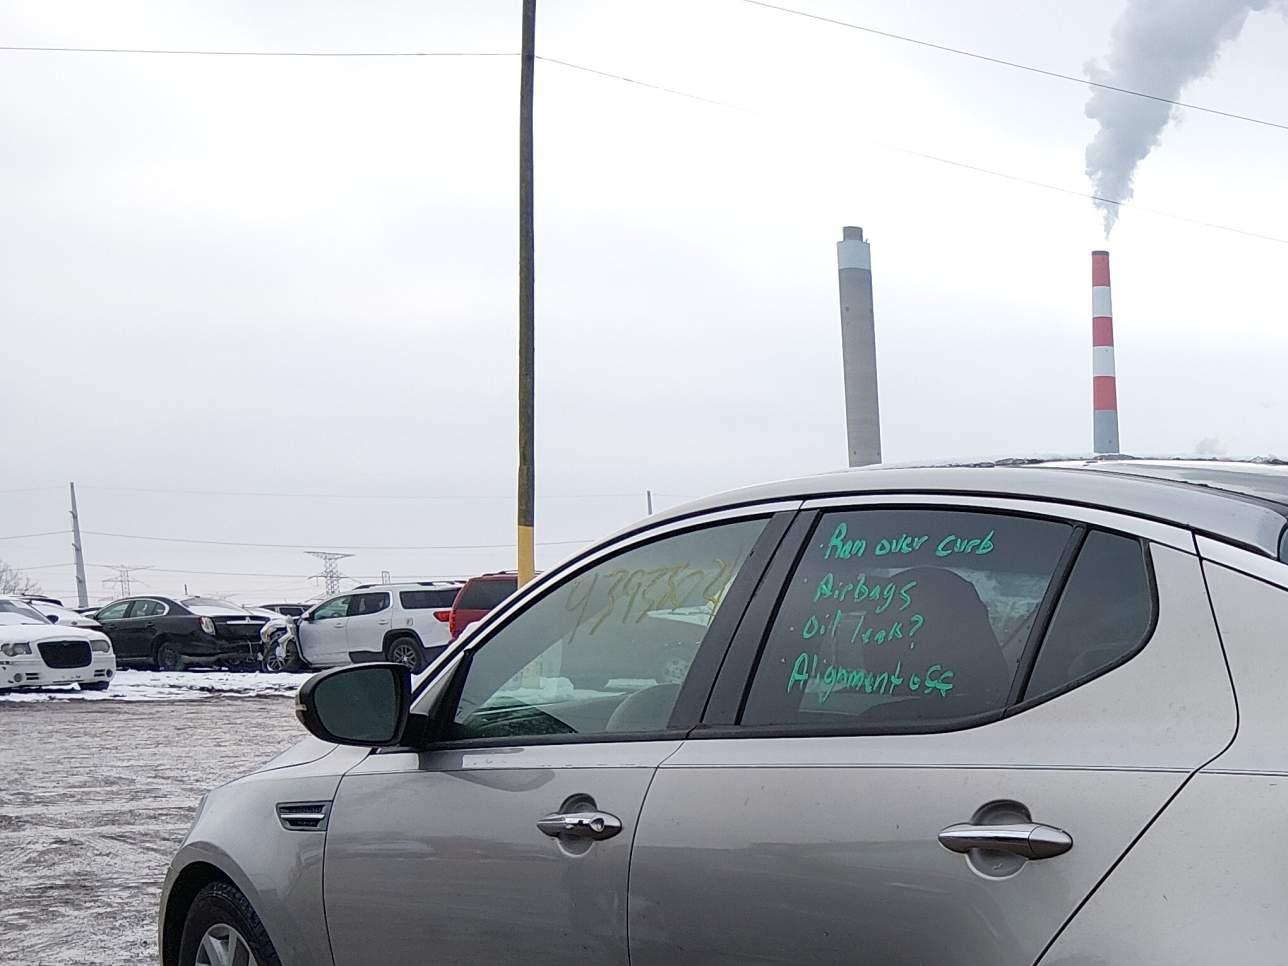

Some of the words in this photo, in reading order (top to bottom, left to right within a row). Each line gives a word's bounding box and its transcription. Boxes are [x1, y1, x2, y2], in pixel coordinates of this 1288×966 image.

[824, 522, 866, 559] Ran
[875, 534, 928, 555] over
[814, 572, 917, 614] Airbags
[802, 609, 842, 639] Oil
[787, 652, 903, 704] Alignment
